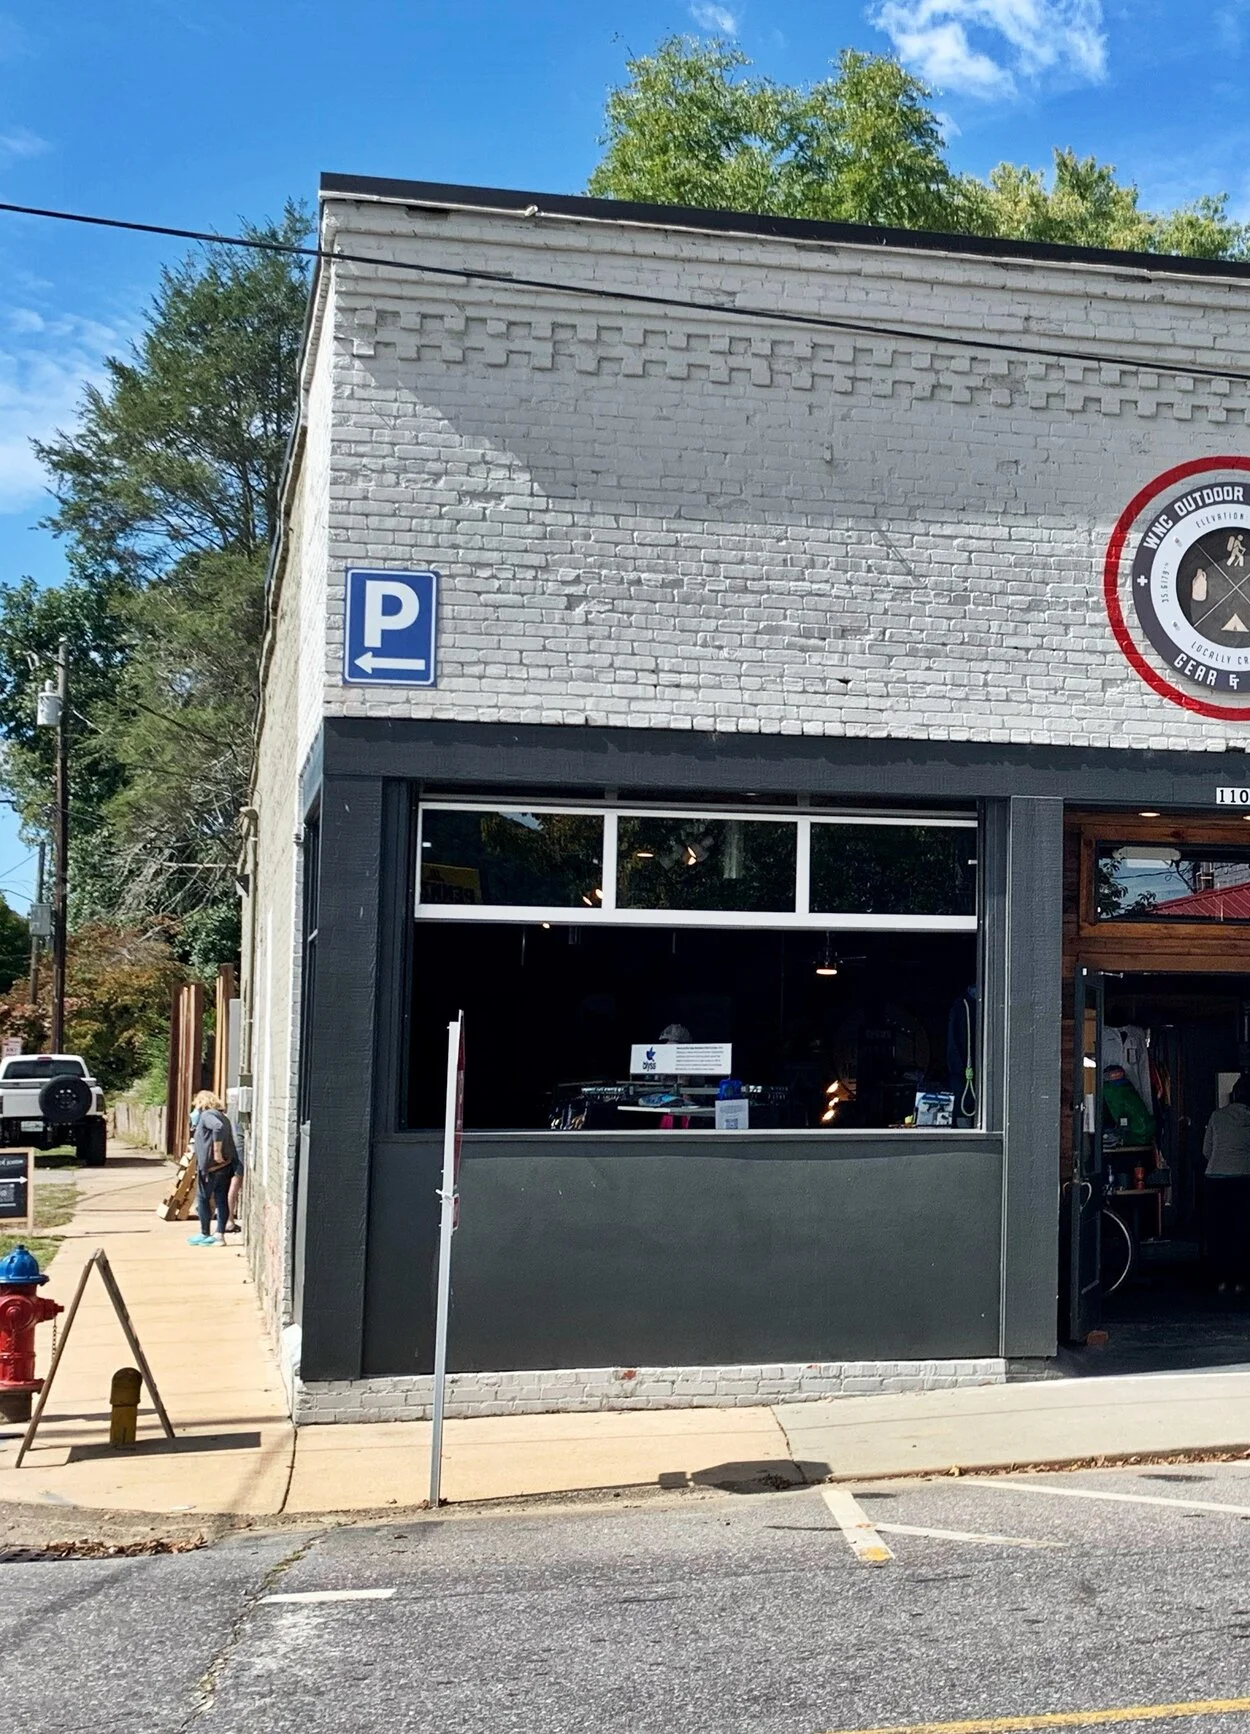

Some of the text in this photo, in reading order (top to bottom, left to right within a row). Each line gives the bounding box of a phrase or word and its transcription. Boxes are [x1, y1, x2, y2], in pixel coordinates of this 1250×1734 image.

[1142, 514, 1174, 550] WNC
[1173, 486, 1244, 517] OUTDOOR
[364, 579, 420, 649] P
[1191, 640, 1232, 665] LOCALLY
[1173, 653, 1218, 687] GEAR
[1228, 673, 1240, 690] &
[1219, 789, 1249, 803] 110
